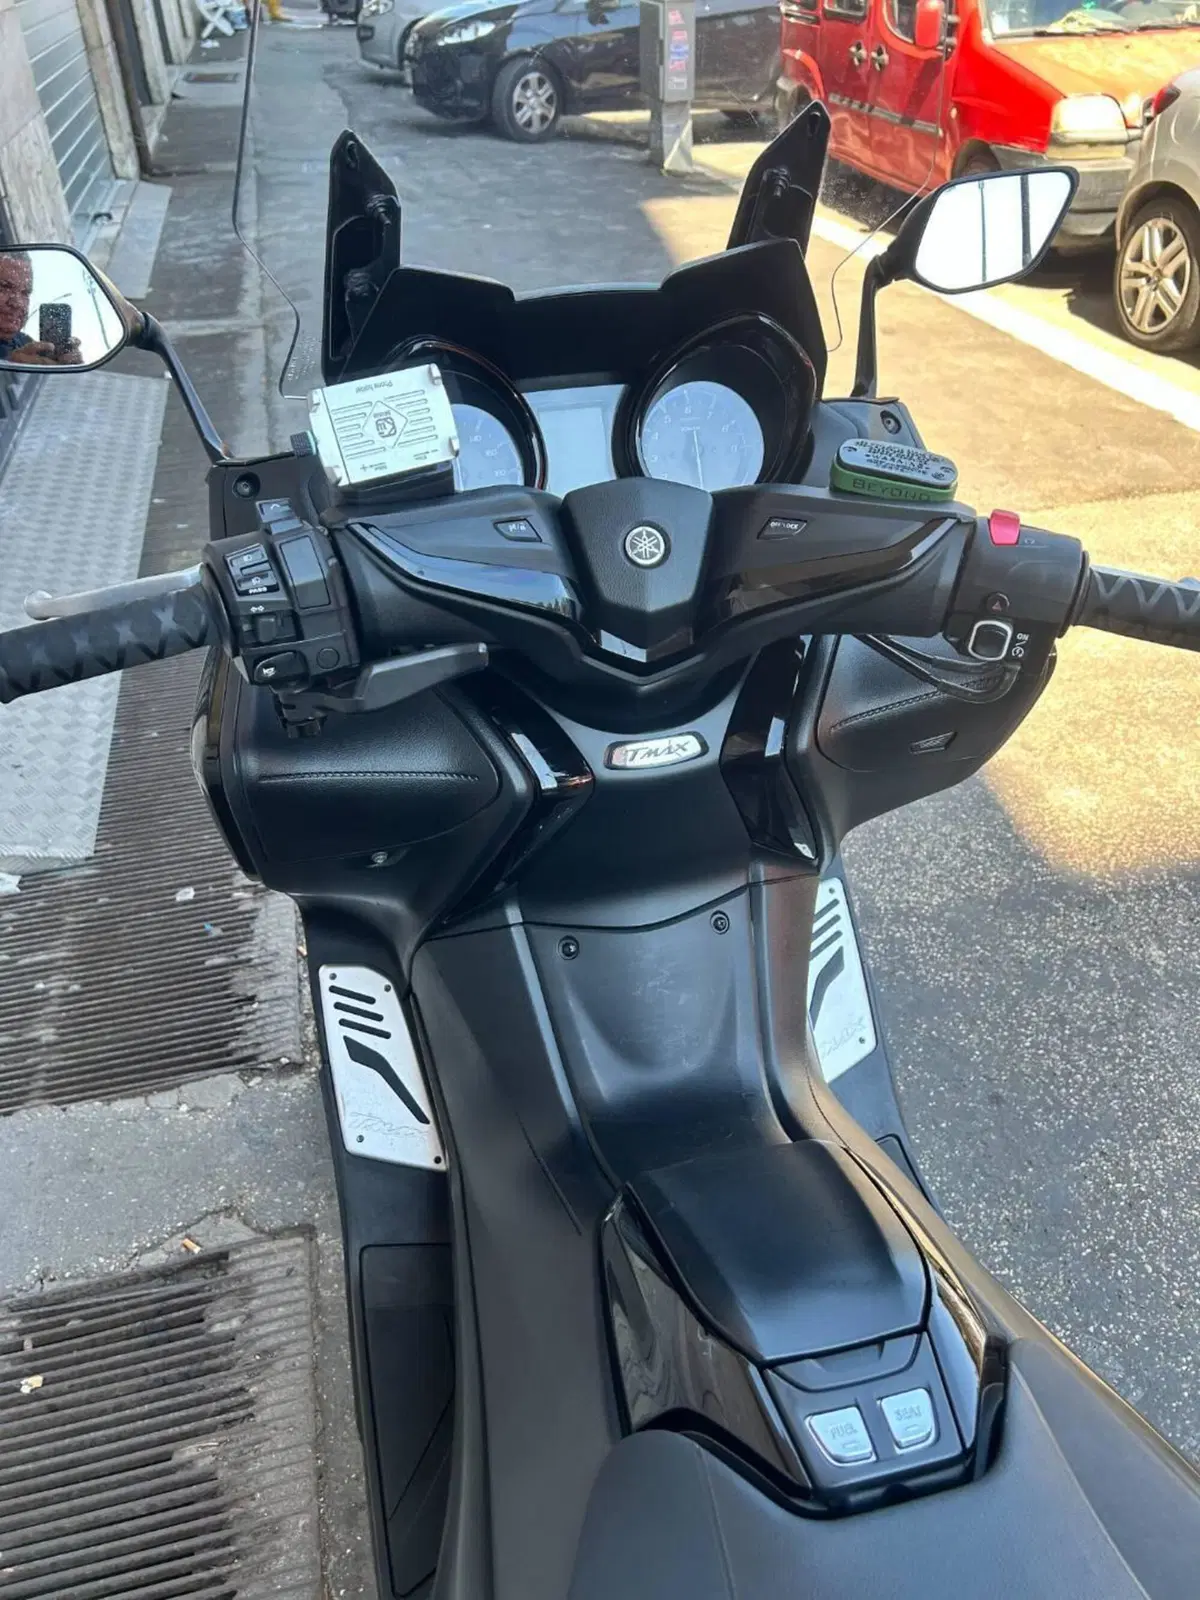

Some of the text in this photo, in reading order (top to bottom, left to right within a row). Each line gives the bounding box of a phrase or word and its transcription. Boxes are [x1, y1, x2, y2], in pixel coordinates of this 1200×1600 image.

[373, 380, 393, 389] Phone
[852, 478, 931, 501] BEYOND
[1016, 632, 1030, 641] ON
